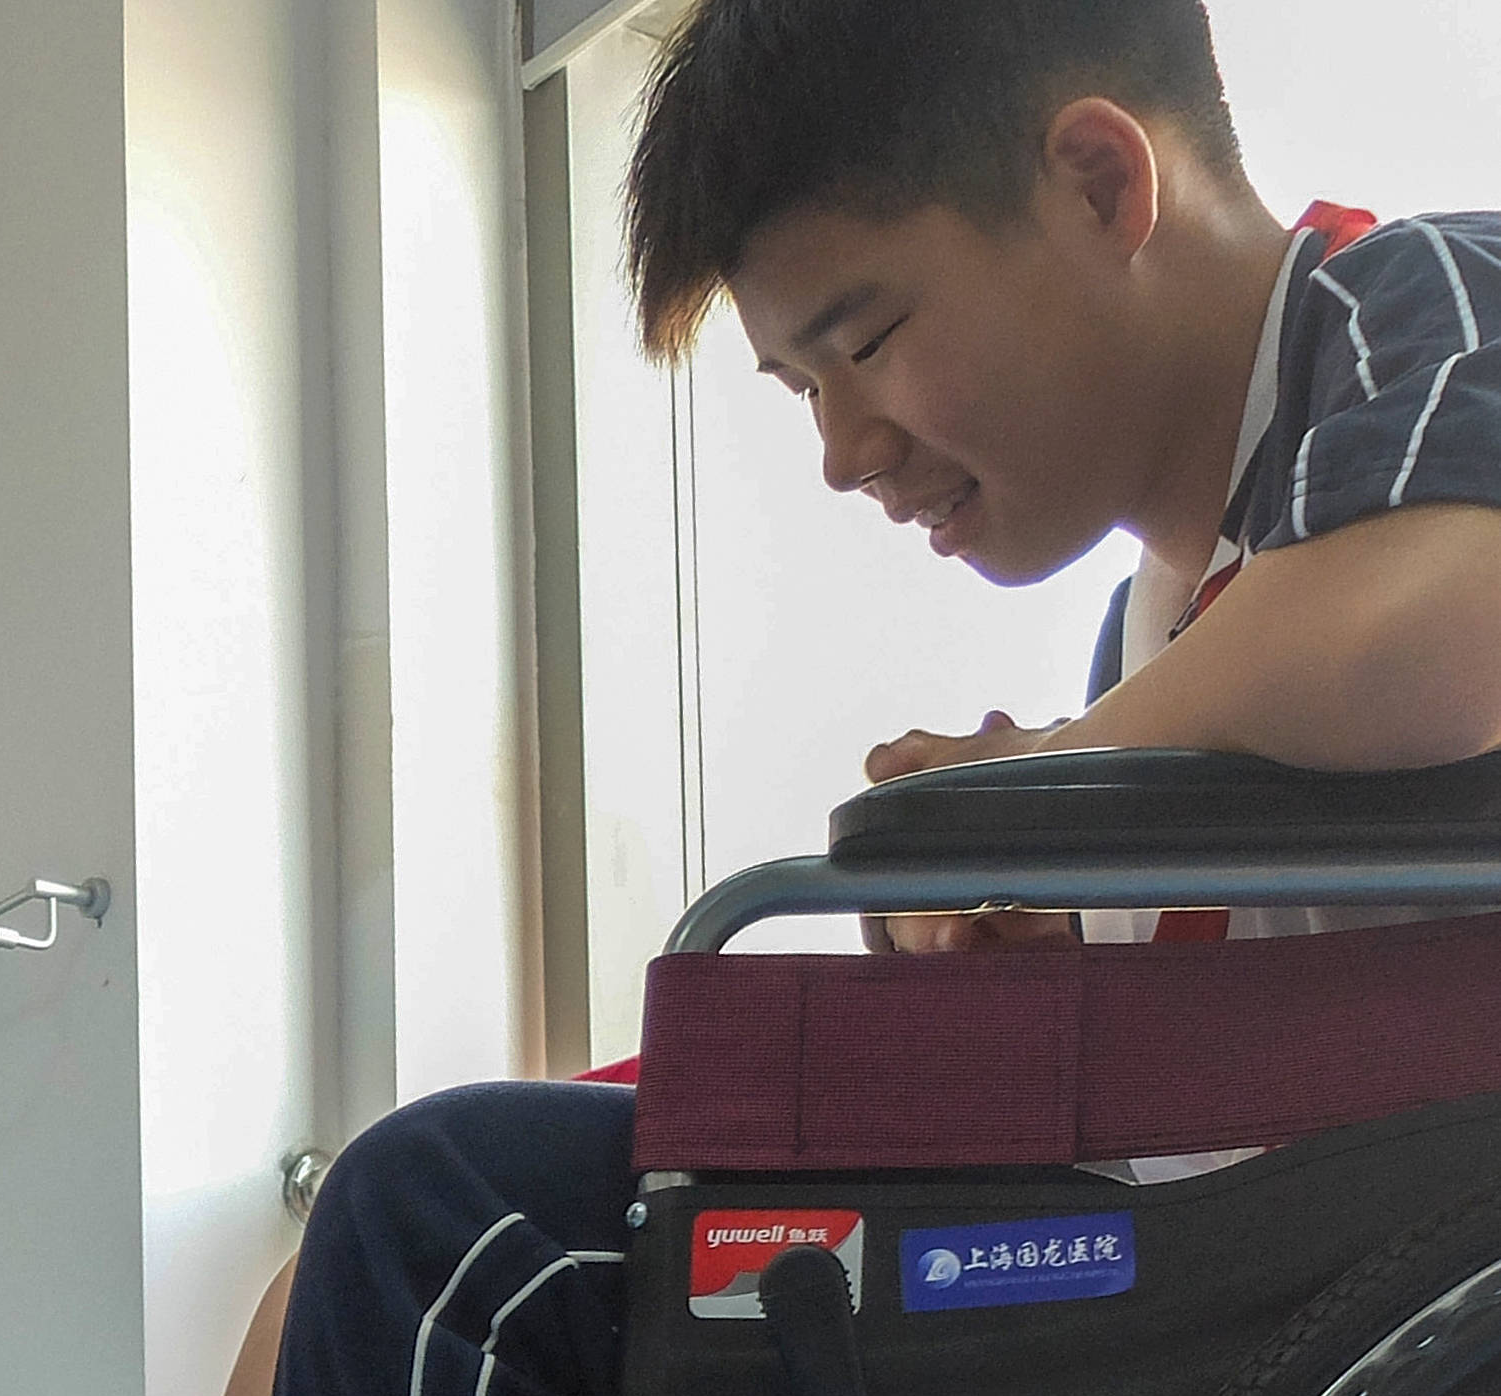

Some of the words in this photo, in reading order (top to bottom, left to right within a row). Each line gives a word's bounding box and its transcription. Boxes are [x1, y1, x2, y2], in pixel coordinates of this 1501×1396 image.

[707, 1225, 785, 1248] yuwell
[787, 1227, 828, 1244] 鱼跃
[963, 1234, 1122, 1271] 上海国龙医院
